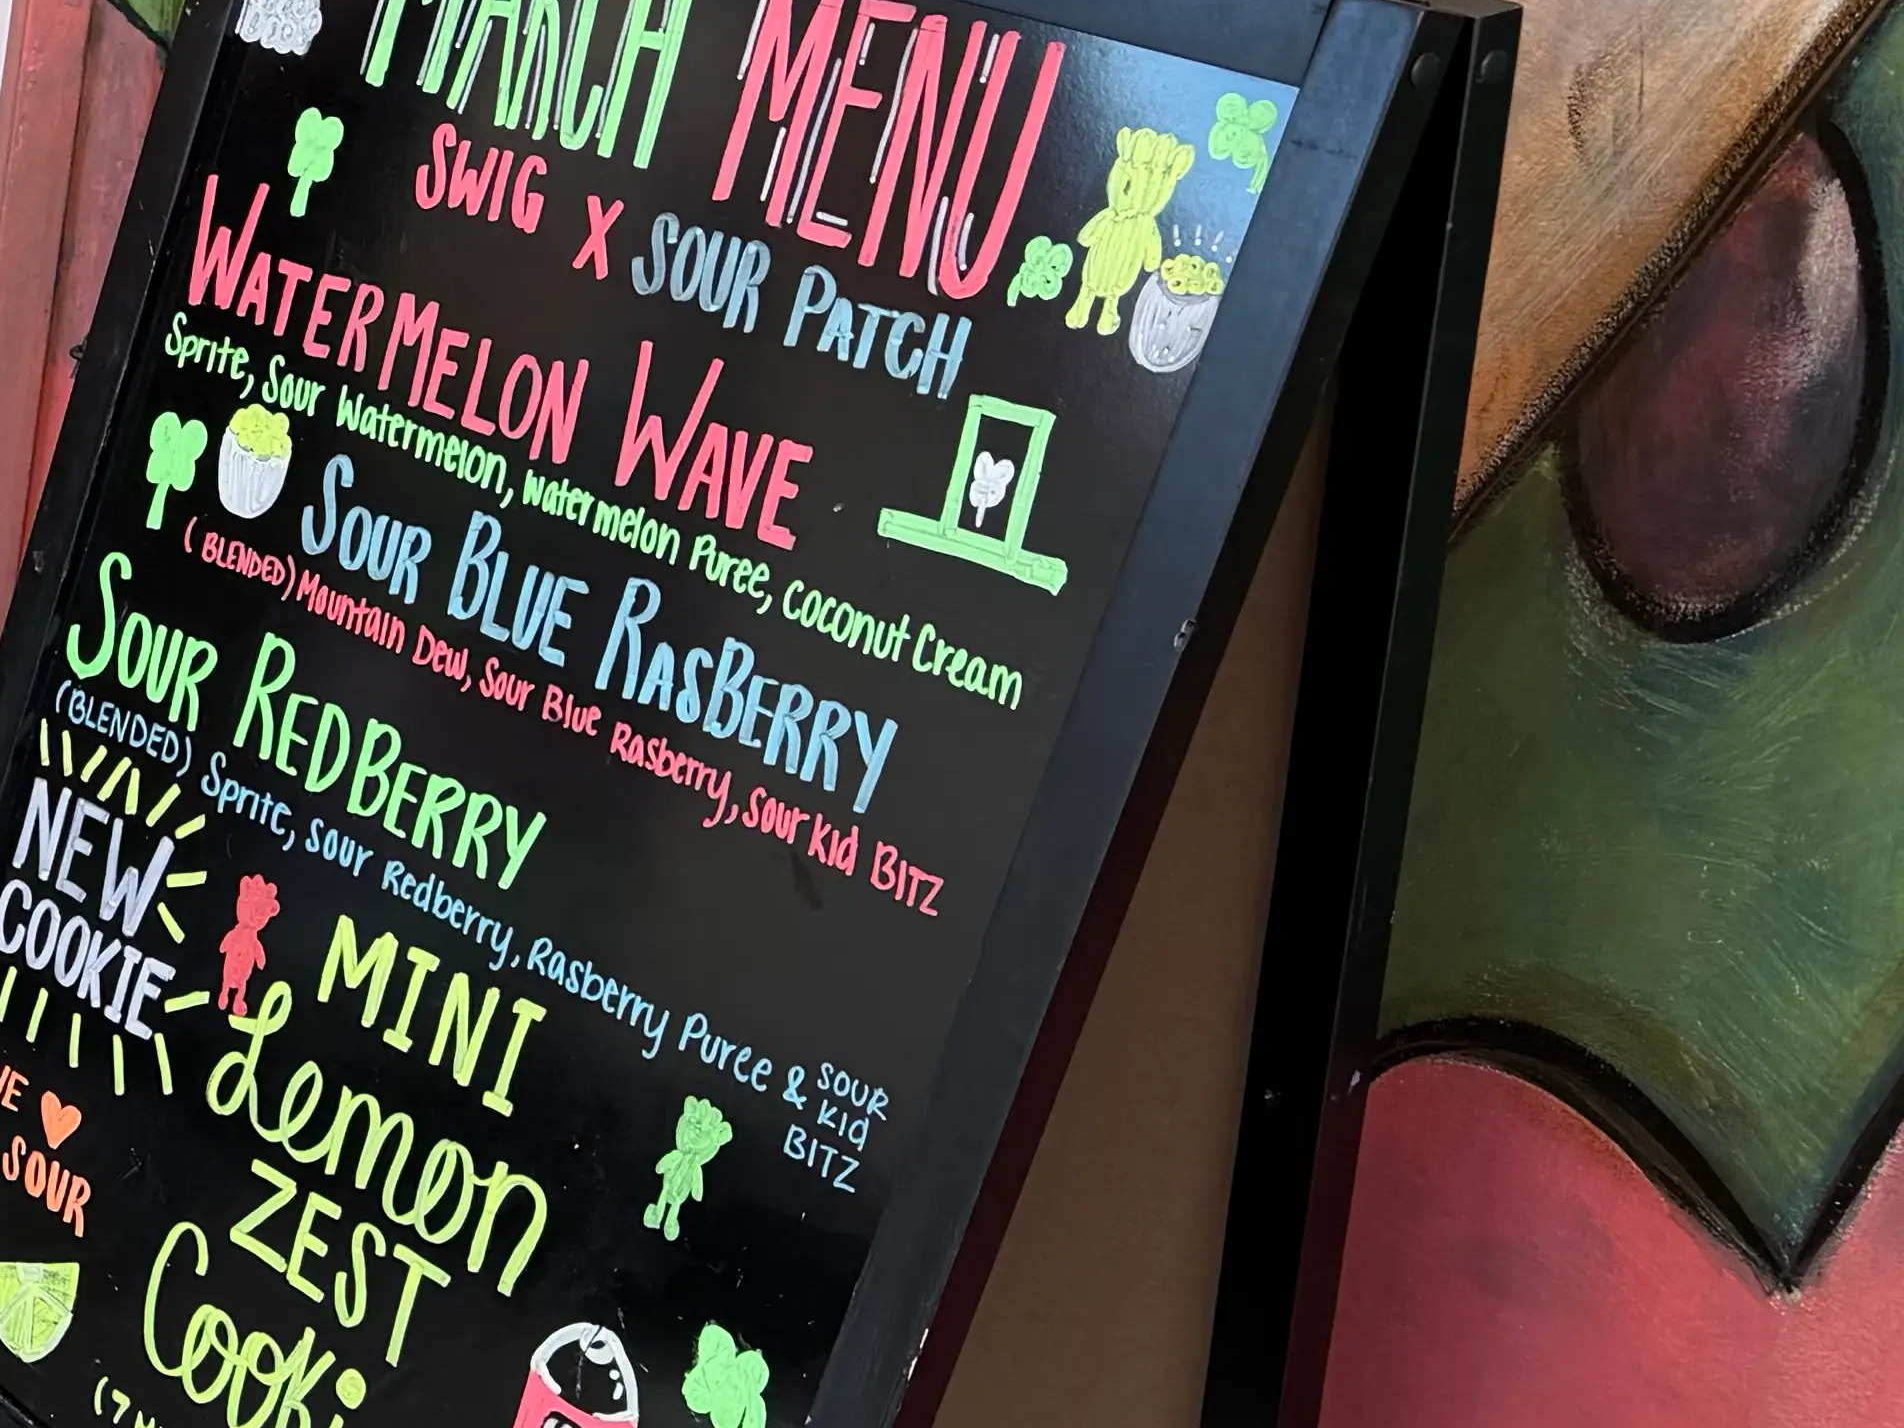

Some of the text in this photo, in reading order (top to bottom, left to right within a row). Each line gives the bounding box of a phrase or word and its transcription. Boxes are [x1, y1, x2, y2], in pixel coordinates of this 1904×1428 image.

[187, 174, 813, 551] WATERMELON WAVE
[415, 122, 548, 234] SWIG
[631, 212, 772, 334] SOUR
[783, 265, 973, 400] PATCH
[165, 312, 255, 399] Sprite,
[688, 532, 773, 615] Puree,
[912, 623, 1023, 710] Cream
[301, 454, 432, 605] SOUR
[447, 510, 590, 668] BLUE
[13, 777, 174, 938] NEW
[65, 552, 546, 890] SOUR REDBERRY
[295, 569, 406, 654] Mountain
[411, 625, 473, 693] Dew,
[541, 683, 603, 736] Blue
[870, 841, 945, 917] BITZ
[56, 680, 192, 777] (BLENDED)
[200, 751, 296, 852] Sprite,
[381, 860, 520, 972] Redberry,
[526, 936, 670, 1060] Rasberry
[678, 1012, 773, 1092] Puree
[782, 1065, 808, 1110] &
[317, 914, 547, 1117] MINI
[2, 1135, 91, 1238] SOUR
[206, 980, 548, 1297] Lemon
[229, 1158, 451, 1367] ZEST
[783, 1124, 861, 1194] BITZ
